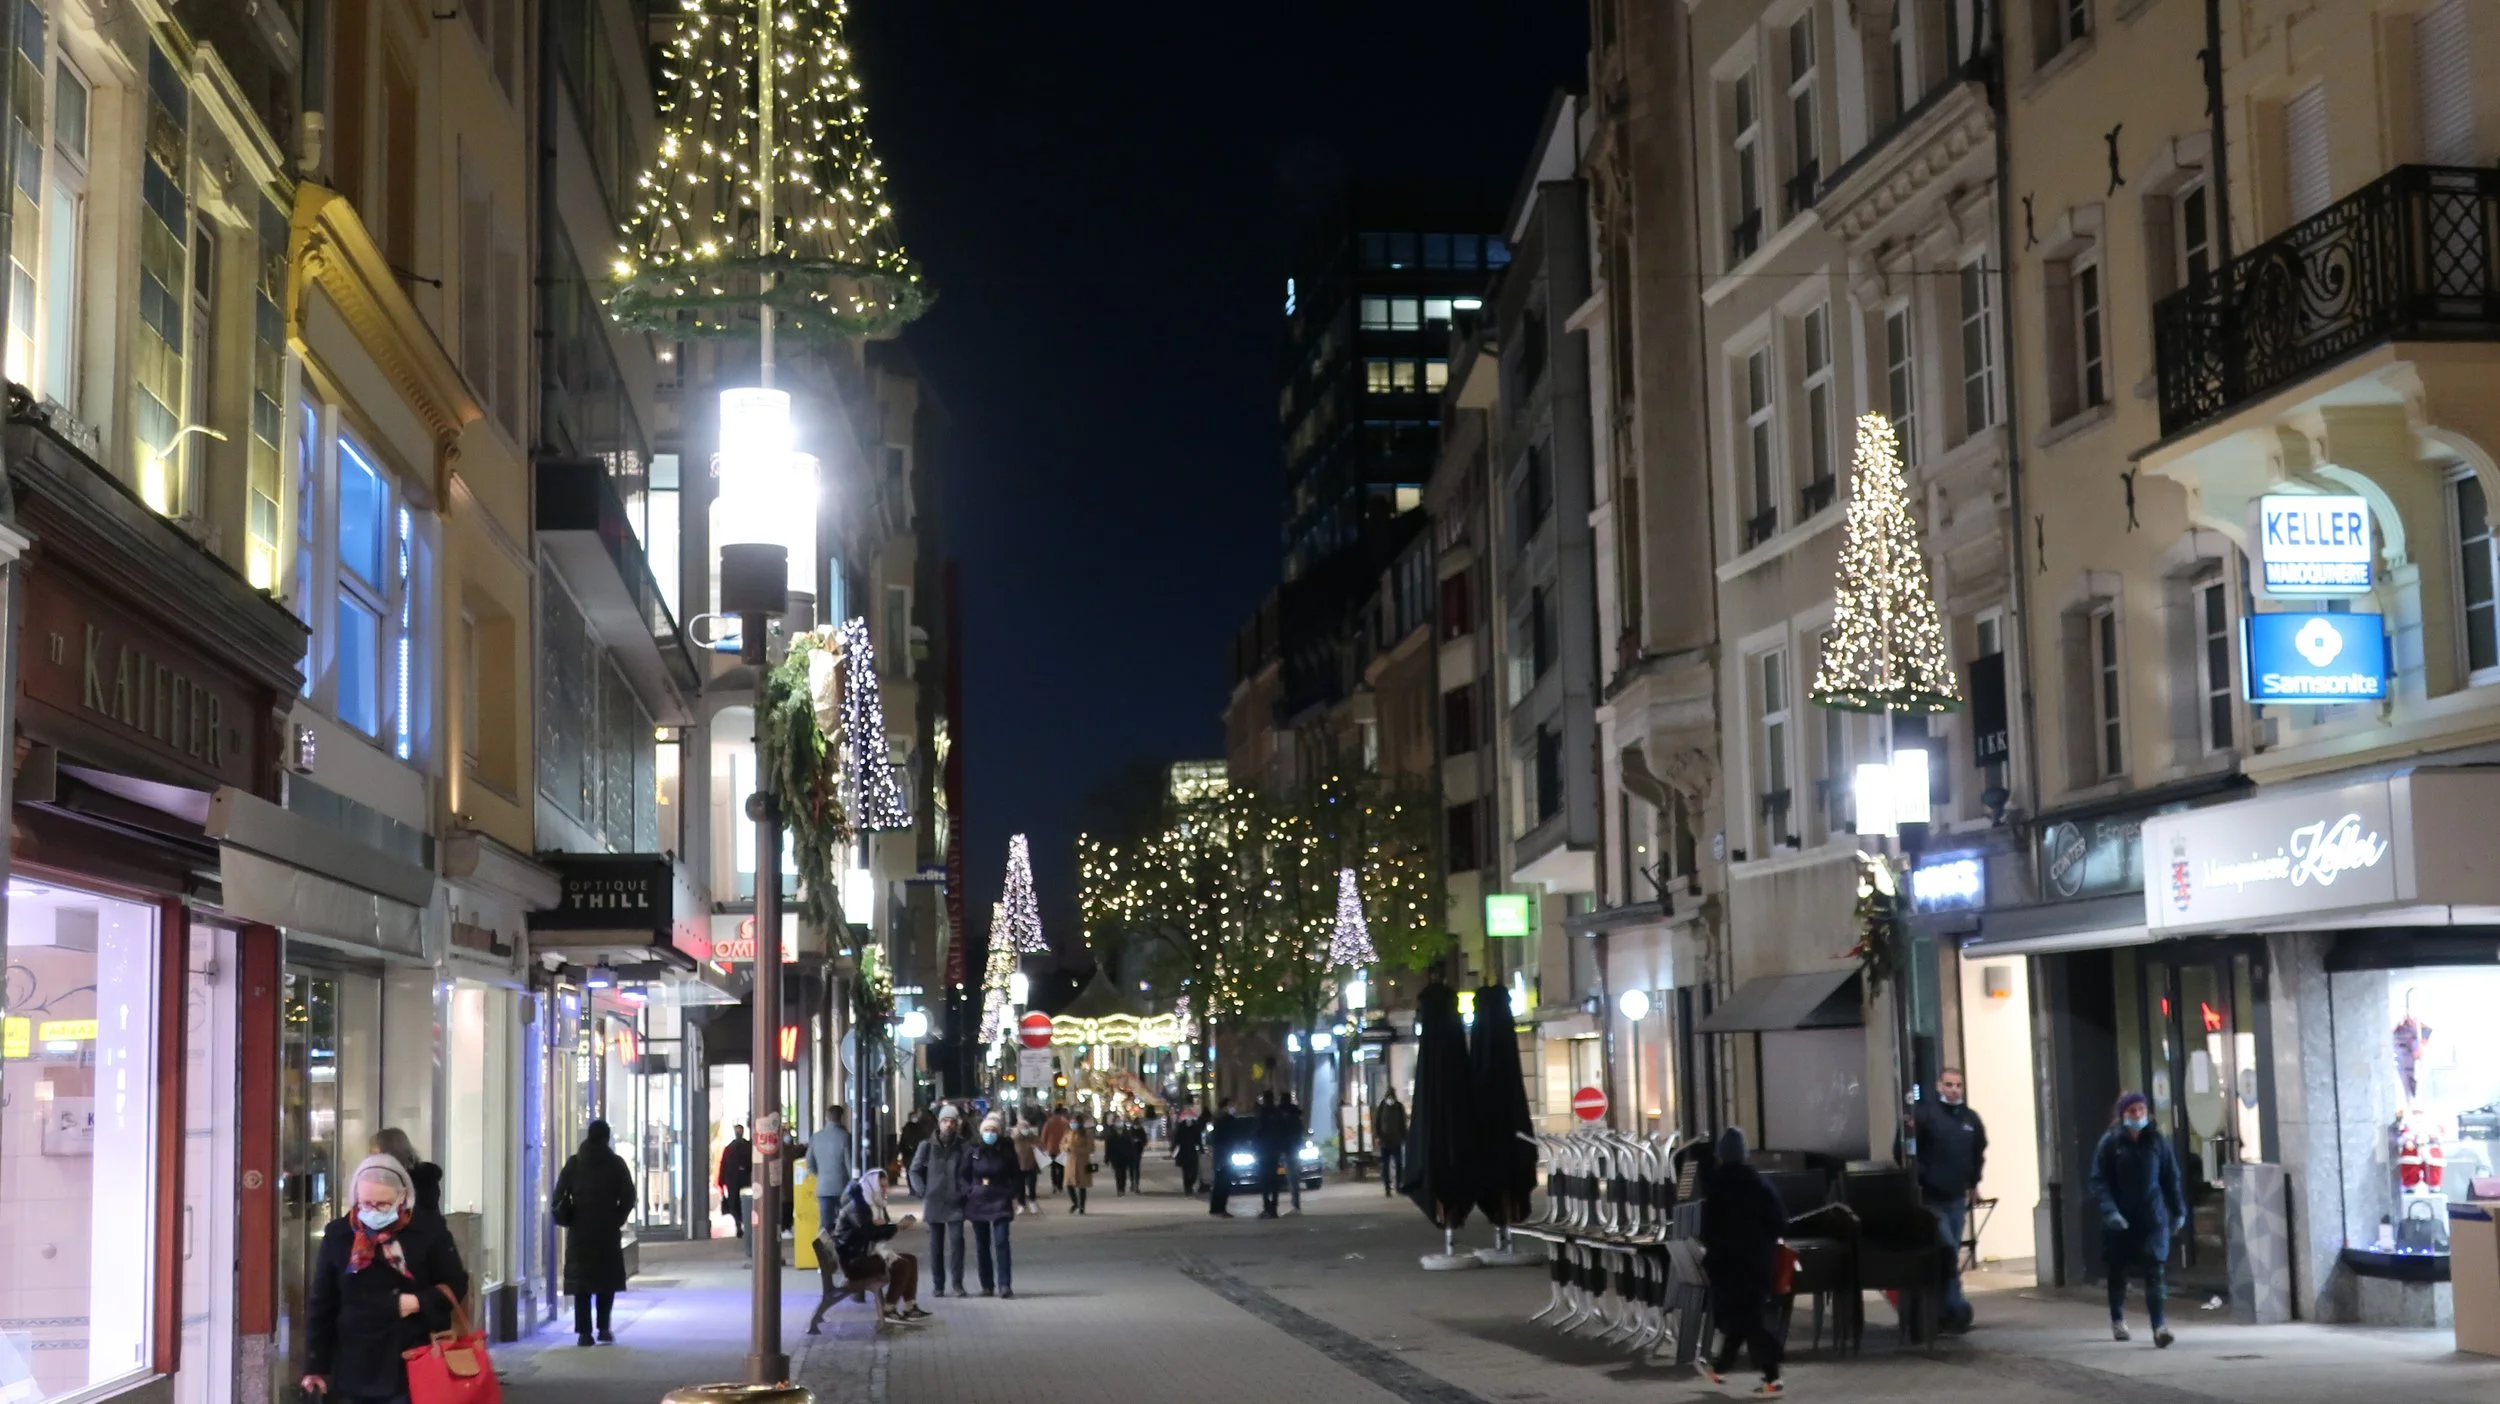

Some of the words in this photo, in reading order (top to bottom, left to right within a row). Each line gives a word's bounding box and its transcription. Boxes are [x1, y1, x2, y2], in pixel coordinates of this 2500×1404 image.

[2267, 512, 2363, 546] KELLER
[2266, 562, 2369, 584] MAROQUINERIE
[84, 622, 222, 768] KAIFFER
[2262, 673, 2378, 694] Samsonite
[2050, 837, 2087, 880] CONTER
[2290, 813, 2388, 887] Keller
[569, 880, 649, 892] OPTIQUE
[571, 893, 649, 909] THILL
